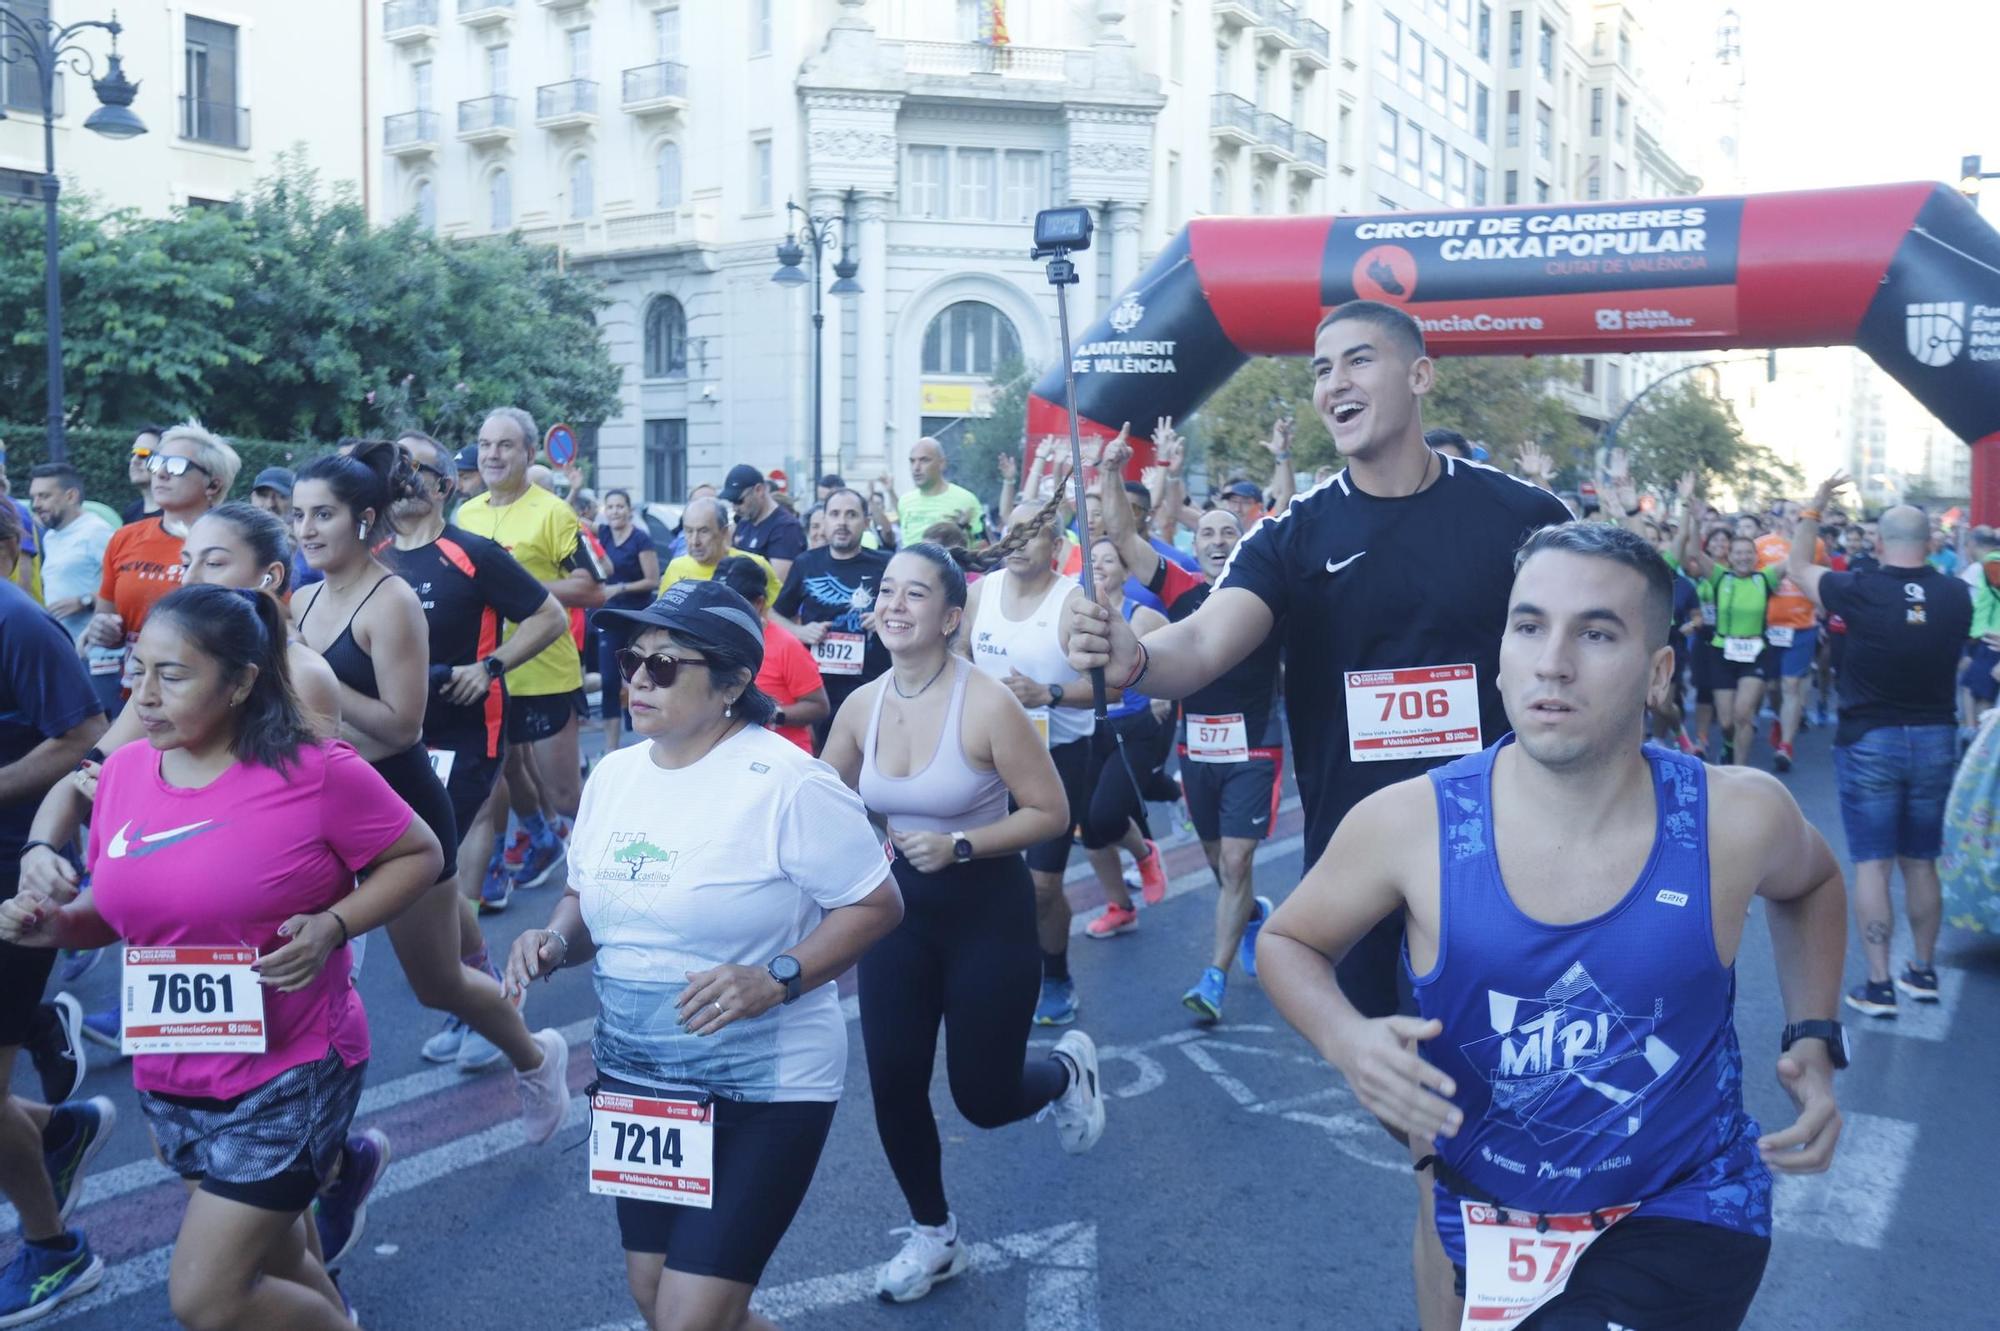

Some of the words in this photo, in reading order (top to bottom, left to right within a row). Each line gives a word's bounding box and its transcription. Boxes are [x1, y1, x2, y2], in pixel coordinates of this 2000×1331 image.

[1355, 219, 1475, 240] CIRCUIT
[1478, 217, 1523, 235] DE
[1526, 207, 1707, 233] CARRERES
[1545, 260, 1598, 275] CIUTAT
[1602, 258, 1624, 273] DE
[1414, 314, 1544, 333] ènciaCorre
[1075, 341, 1176, 357] AJUNTAMENT
[1071, 360, 1090, 373] DE
[1094, 356, 1177, 373] VALÈNCIA
[818, 642, 852, 660] 6972
[977, 643, 1007, 656] POBLA
[1375, 688, 1450, 721] 706
[1200, 727, 1229, 742] 577
[1383, 735, 1440, 746] #ValènciaCorre
[638, 870, 671, 880] castillos
[148, 973, 233, 1014] 7661
[1654, 997, 1664, 1019] 2023
[160, 1025, 223, 1035] #ValènciaCorre
[611, 1121, 683, 1168] 7214
[619, 1173, 673, 1188] #ValènciaCorre
[1508, 1237, 1586, 1284] 57
